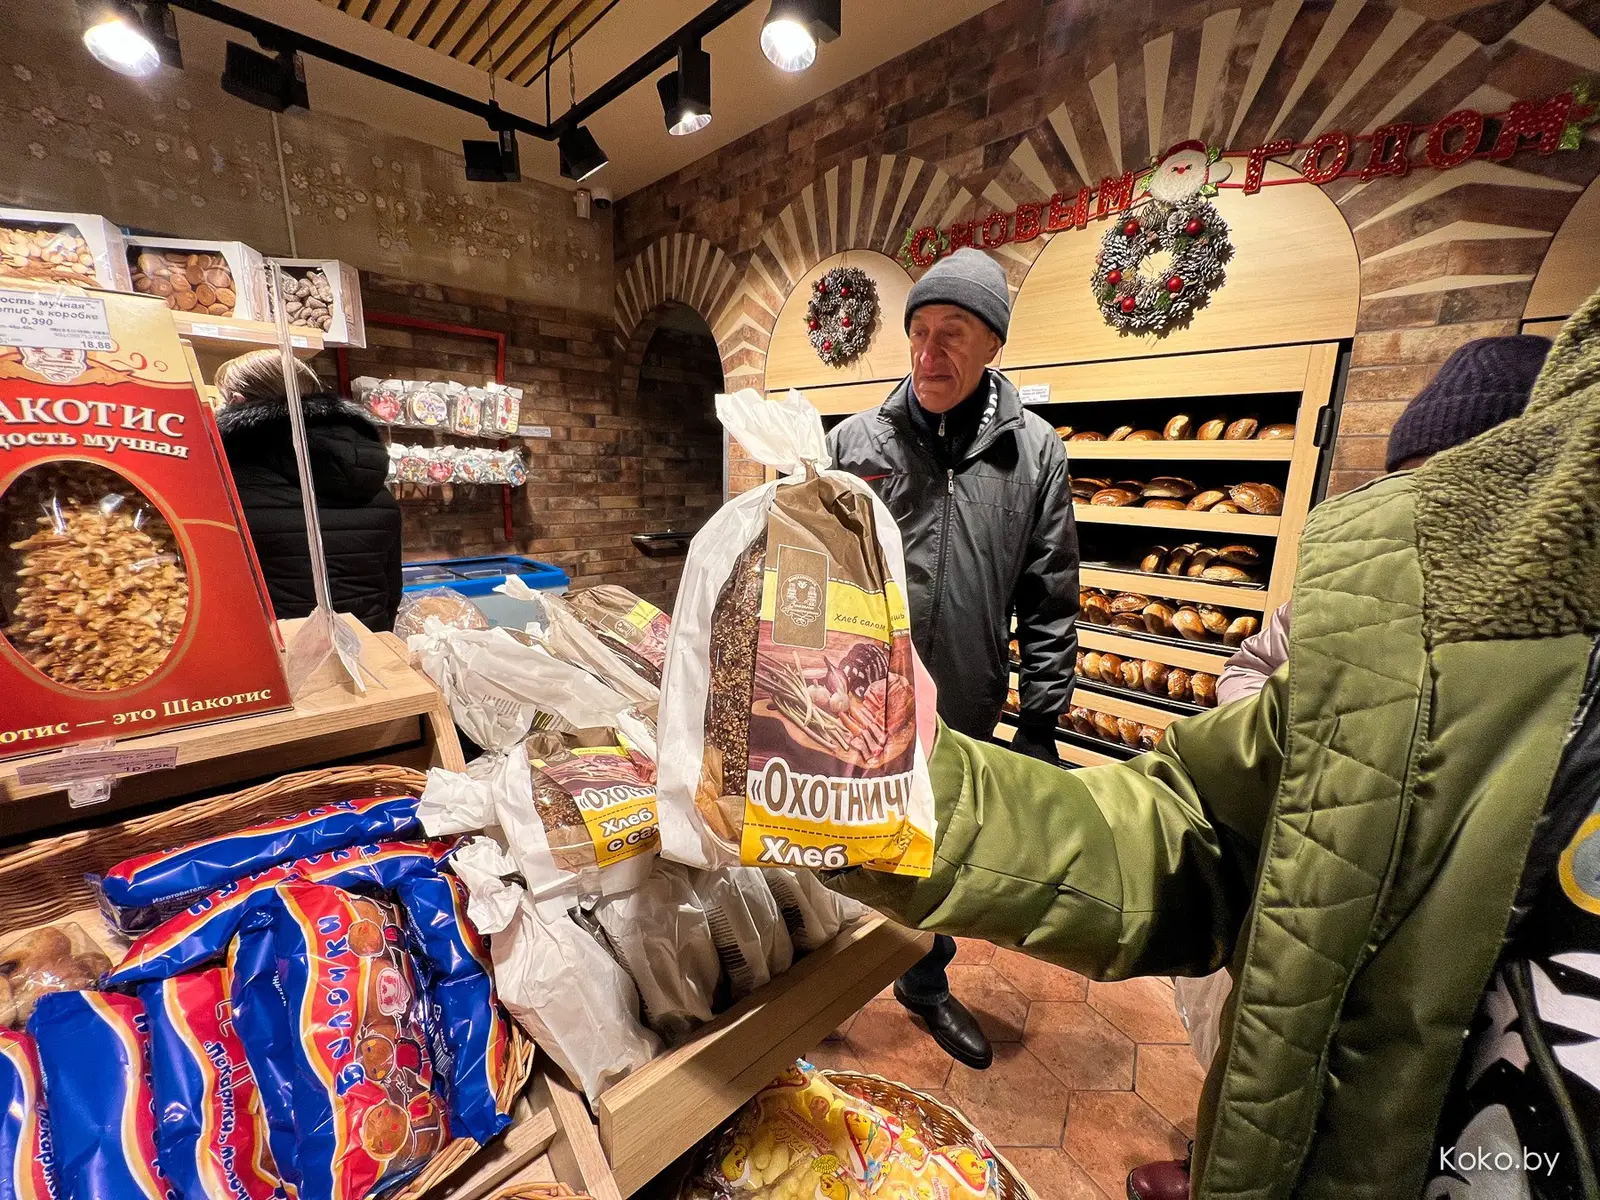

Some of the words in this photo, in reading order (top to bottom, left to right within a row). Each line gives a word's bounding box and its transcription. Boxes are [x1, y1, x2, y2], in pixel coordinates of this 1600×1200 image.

[951, 171, 1136, 252] НОВЫМ
[1242, 91, 1576, 196] ГОДОМ
[81, 432, 190, 460] мучная
[112, 708, 158, 726] это
[161, 688, 272, 718] Шакотис
[599, 807, 655, 838] Хлеб
[757, 835, 850, 870] Хлеб
